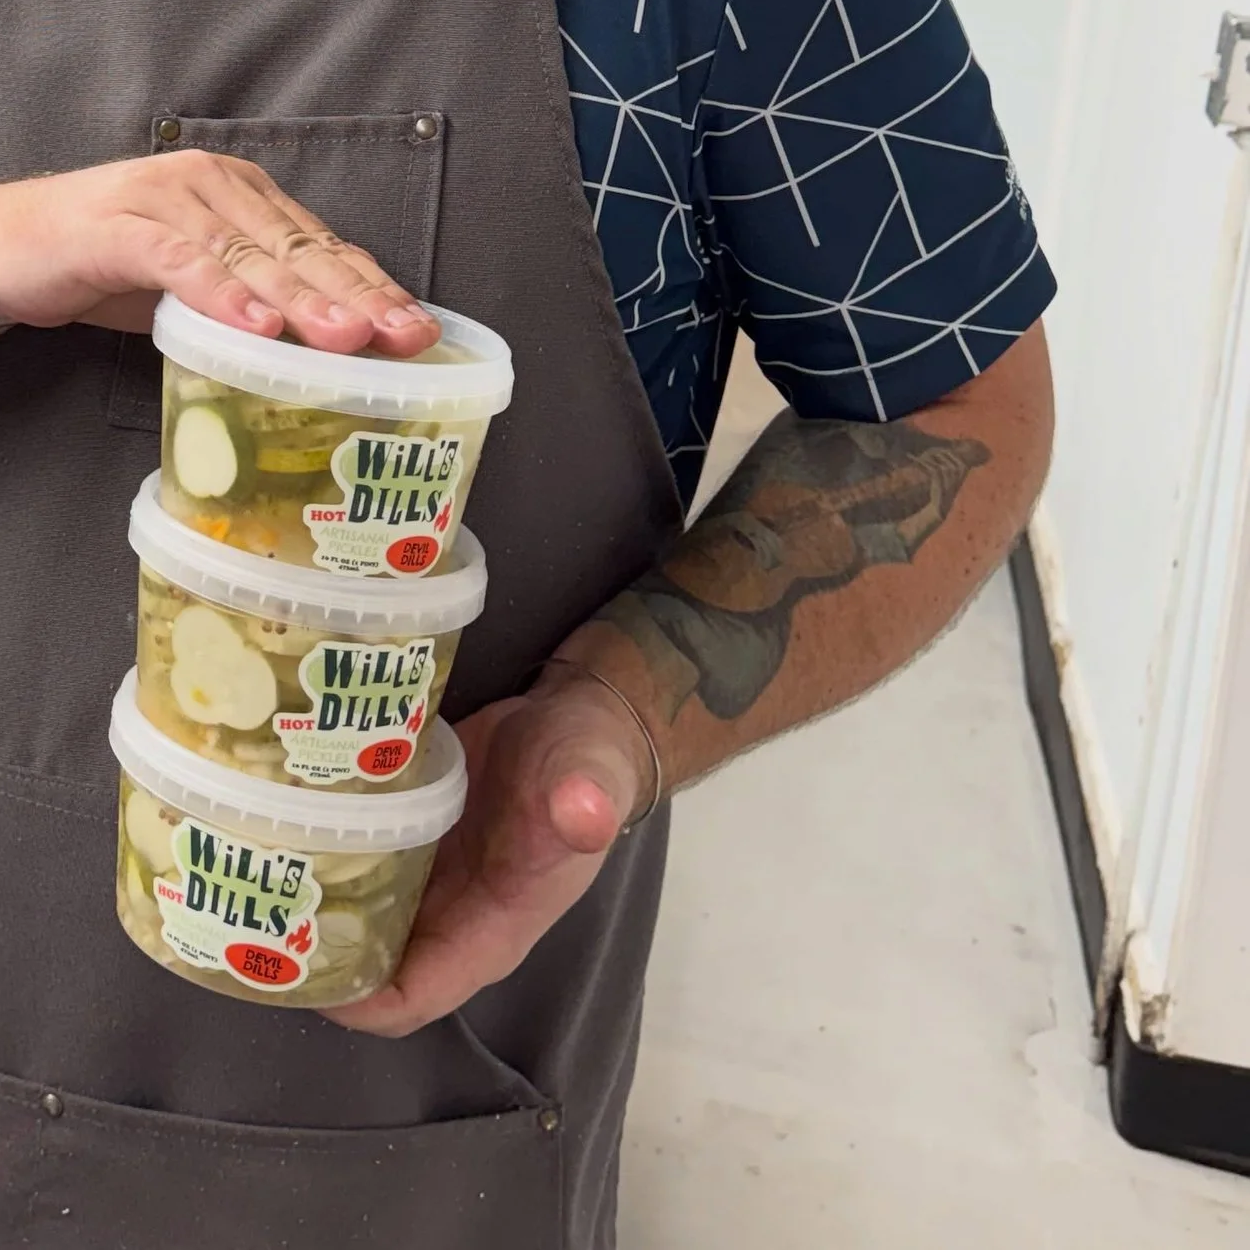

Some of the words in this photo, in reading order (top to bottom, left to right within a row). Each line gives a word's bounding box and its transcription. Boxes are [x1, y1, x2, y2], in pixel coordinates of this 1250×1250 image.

[310, 509, 346, 522] HOT
[348, 483, 443, 525] DILLS
[403, 541, 430, 554] DEVIL
[400, 553, 427, 567] DILLS
[280, 719, 315, 730] HOT
[318, 692, 414, 731] DILLS
[374, 745, 402, 757] DEVIL
[372, 757, 399, 770] DILLS
[158, 884, 184, 904] HOT
[186, 870, 290, 937] DILLS
[245, 948, 284, 971] DEVIL
[243, 960, 280, 980] DILLS
